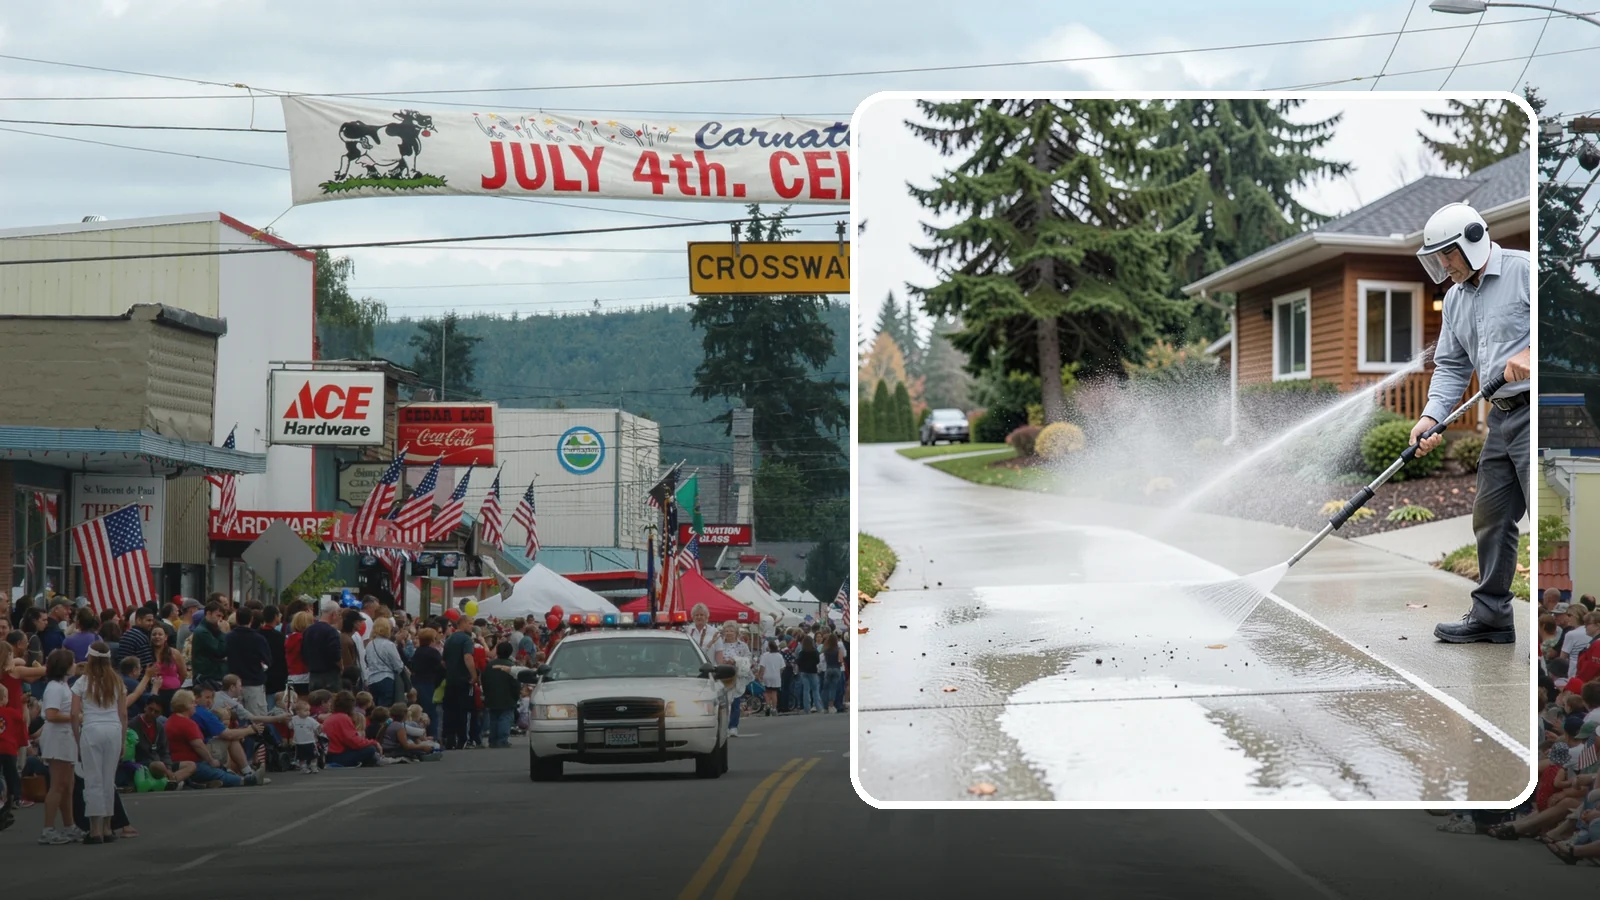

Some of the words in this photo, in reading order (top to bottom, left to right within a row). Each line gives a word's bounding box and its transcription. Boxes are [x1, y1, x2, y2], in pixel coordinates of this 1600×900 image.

[481, 141, 604, 192] JULY
[633, 150, 746, 197] 4th.
[697, 254, 850, 279] CROSSWA
[283, 380, 373, 419] ACE
[405, 409, 452, 421] CEDAR
[284, 421, 370, 436] Hardware
[417, 428, 477, 446] Coca-Cola
[354, 467, 383, 480] Simpl
[96, 485, 124, 494] Vincent
[127, 486, 136, 494] de
[138, 486, 155, 495] Paul
[688, 526, 741, 535] CRNATION
